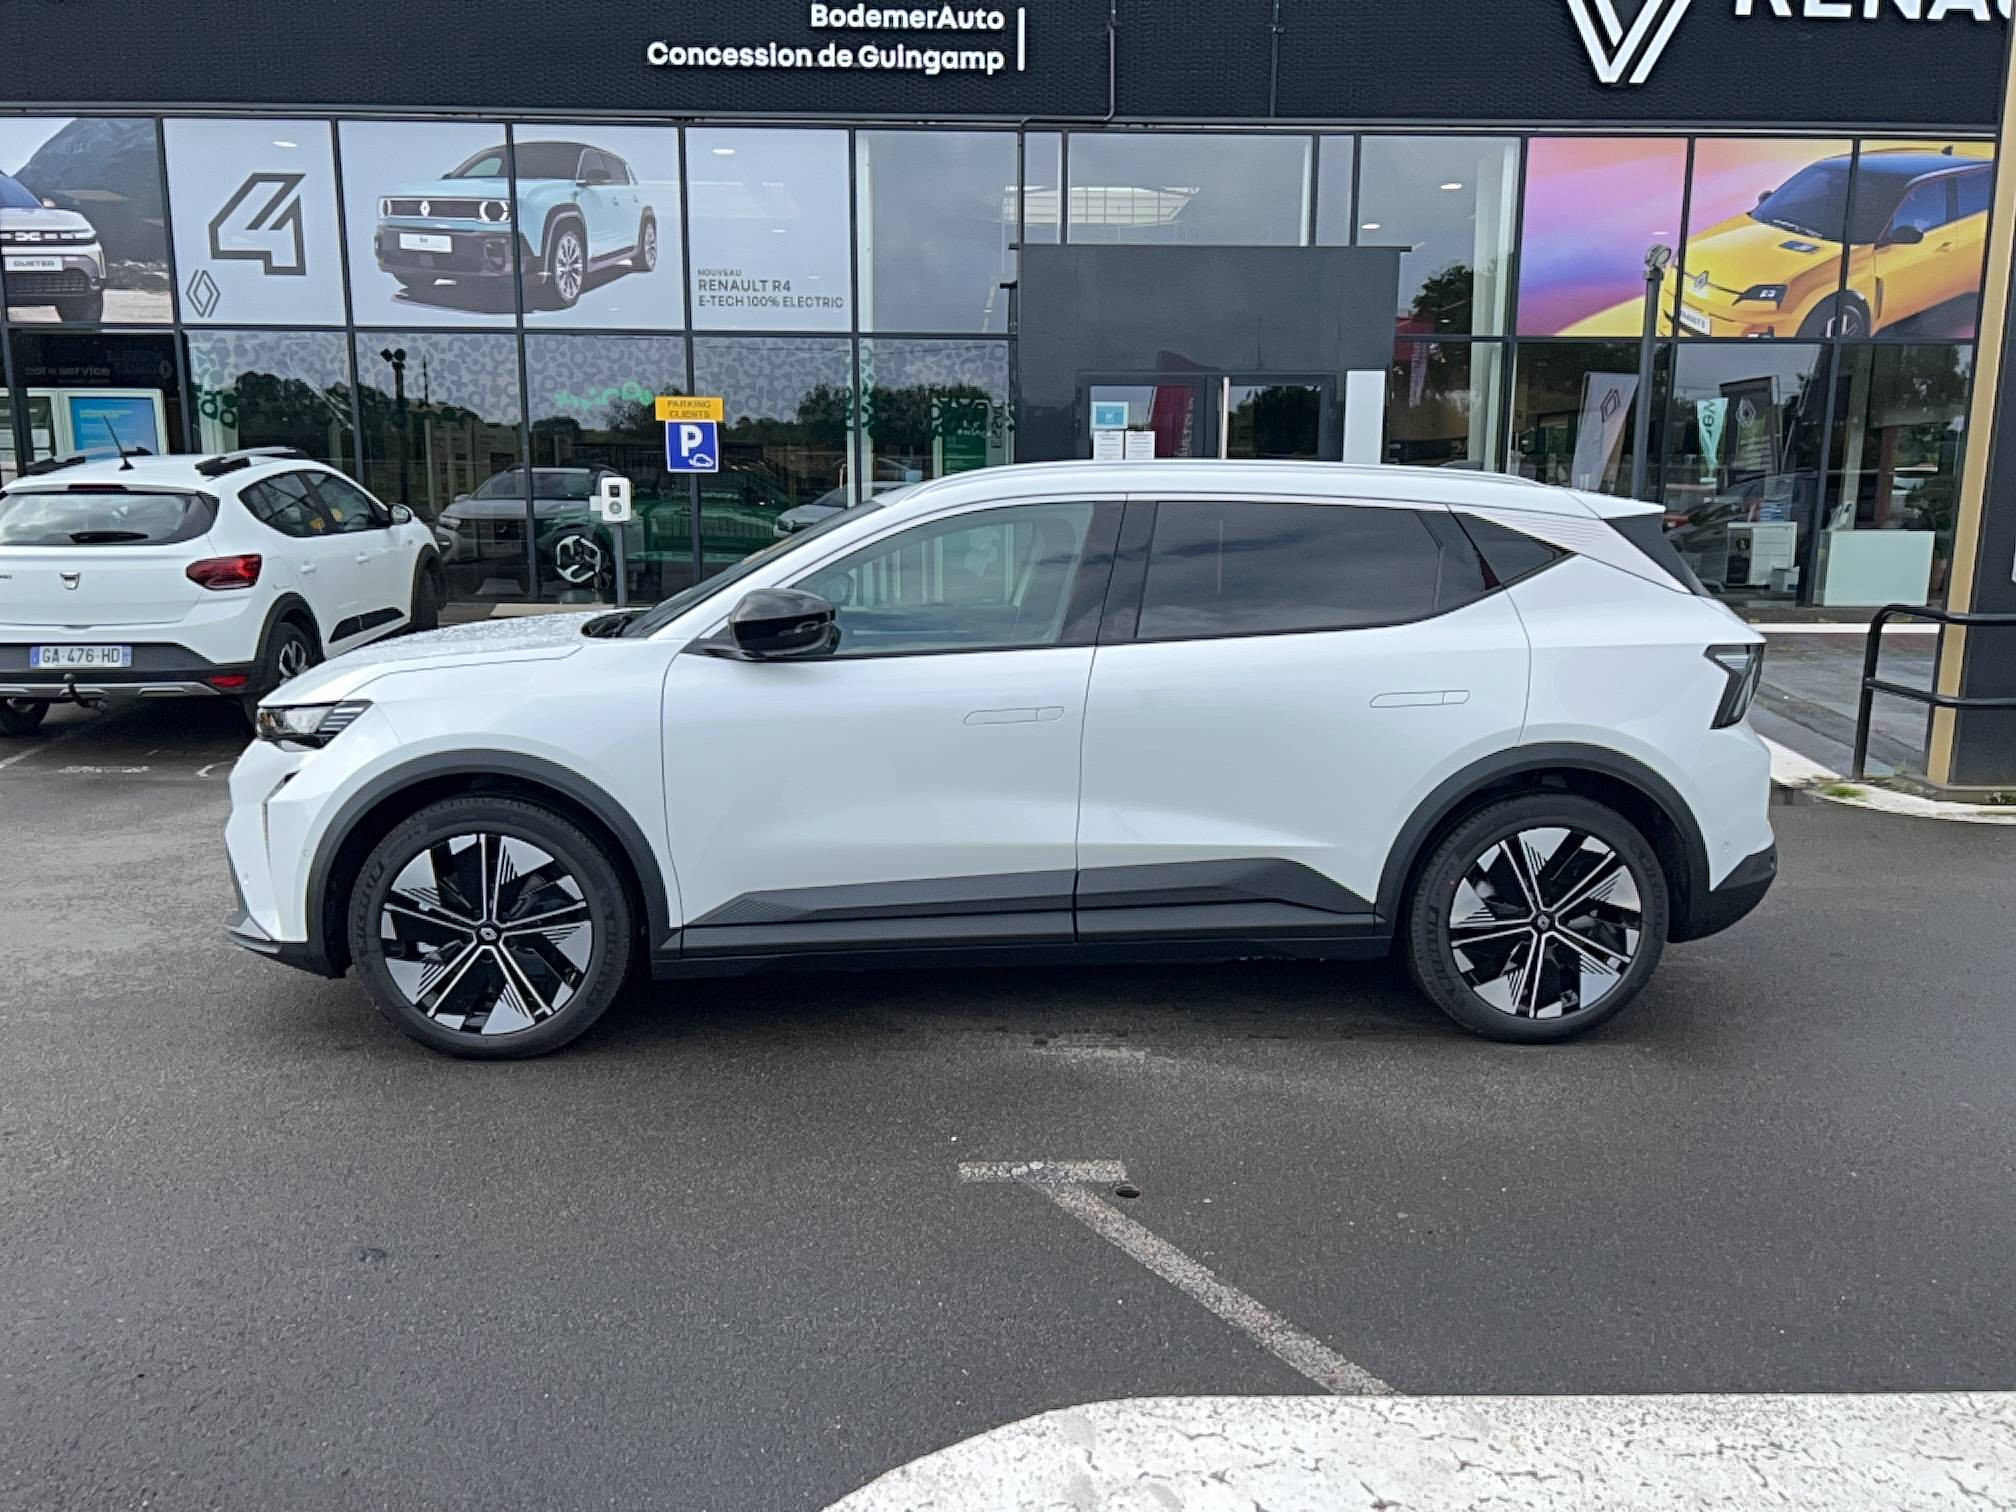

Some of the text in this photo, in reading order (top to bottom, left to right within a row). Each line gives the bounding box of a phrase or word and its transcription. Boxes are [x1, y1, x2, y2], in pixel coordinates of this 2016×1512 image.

[810, 3, 1005, 31] BodemerAuto
[647, 41, 1005, 75] Concession de Guingamp
[698, 279, 791, 293] RENAULT R4
[698, 295, 844, 309] E-TECH 100% ELECTRIC
[667, 400, 711, 409] PARKING
[669, 410, 710, 419] CLIENTS
[680, 425, 703, 456] P
